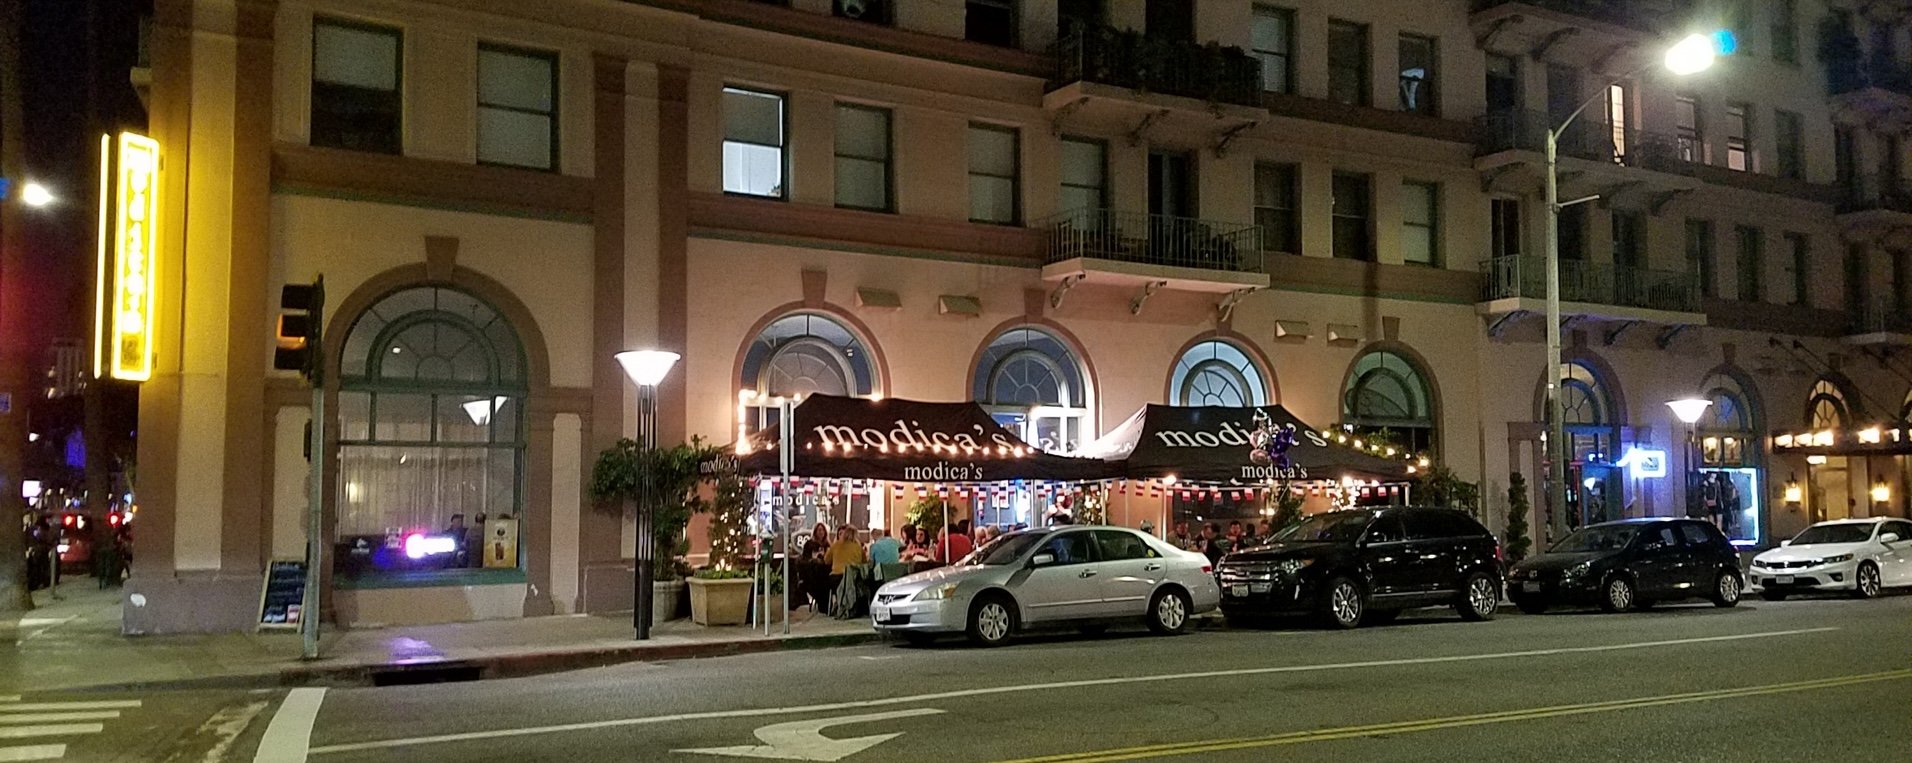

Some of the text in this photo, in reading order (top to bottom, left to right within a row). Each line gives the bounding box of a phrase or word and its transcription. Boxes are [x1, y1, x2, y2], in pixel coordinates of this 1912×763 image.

[813, 419, 1015, 453] modica's
[1155, 421, 1328, 447] modi's
[700, 453, 738, 473] modi's
[904, 460, 984, 480] modica's
[1241, 462, 1308, 479] modica's
[772, 493, 840, 506] modica's
